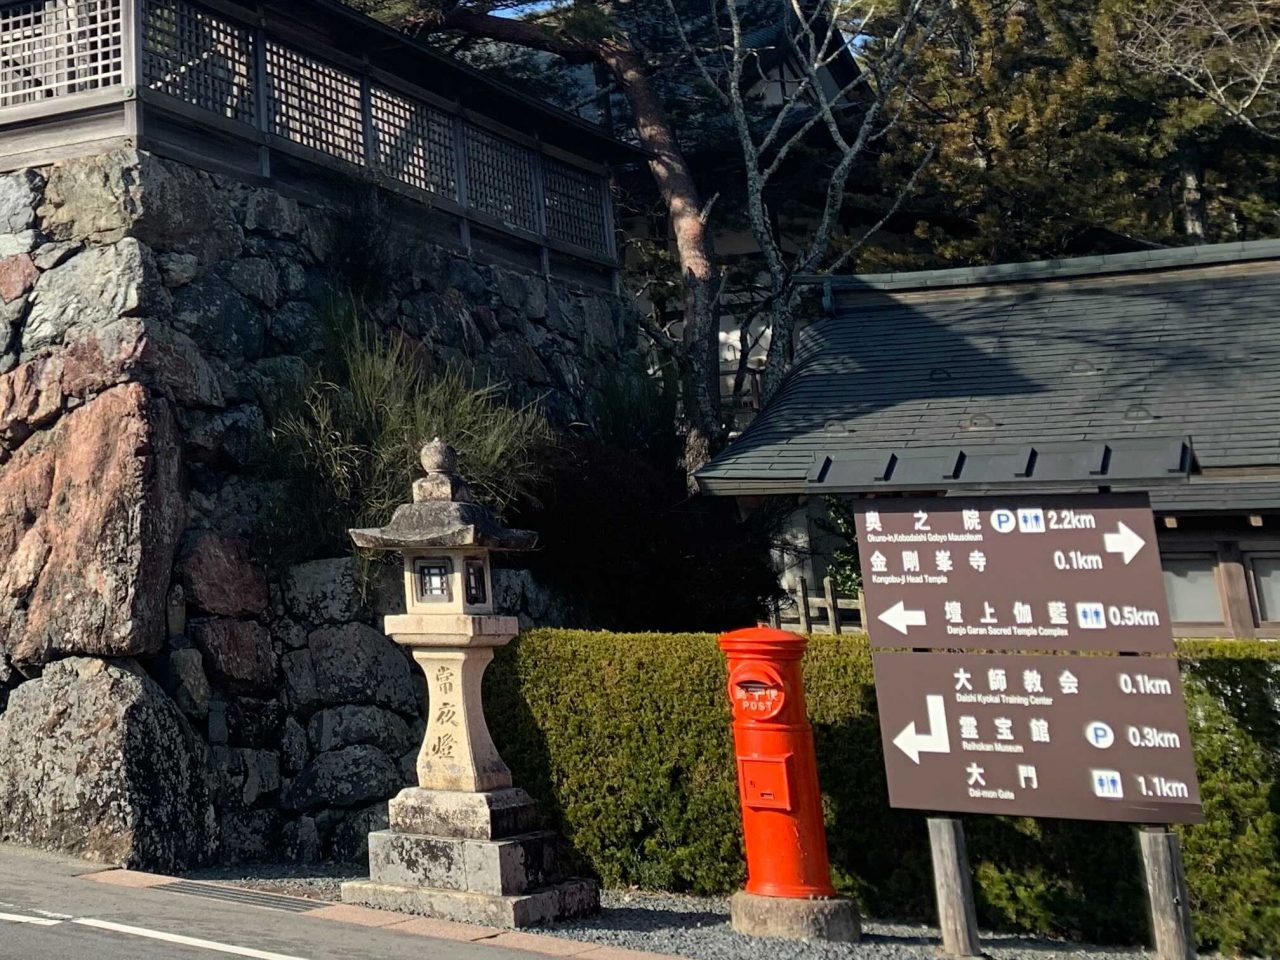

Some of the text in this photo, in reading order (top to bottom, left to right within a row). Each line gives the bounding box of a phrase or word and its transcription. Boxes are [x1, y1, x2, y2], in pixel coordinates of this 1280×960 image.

[1047, 510, 1096, 529] 2.2km
[1053, 550, 1103, 570] 0.1km
[1108, 605, 1160, 626] 0.5km
[953, 668, 1171, 695] 大師教会 0.1km
[742, 700, 773, 711] POST
[1128, 726, 1181, 748] 0.3km
[966, 762, 1189, 798] 大門 1.1km
